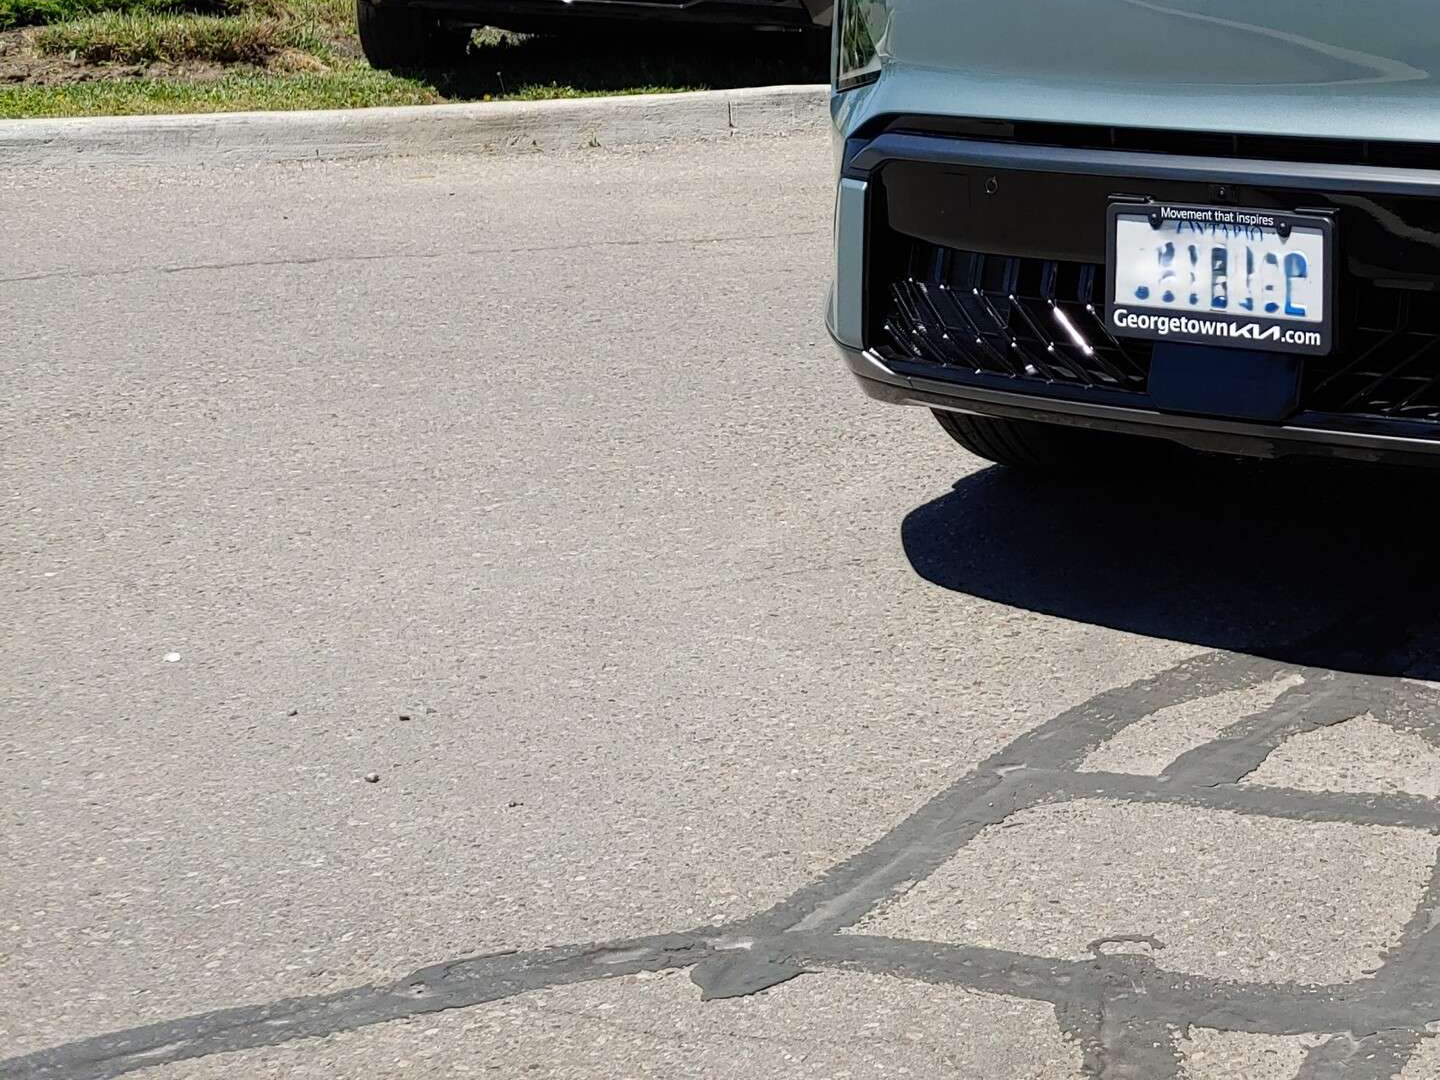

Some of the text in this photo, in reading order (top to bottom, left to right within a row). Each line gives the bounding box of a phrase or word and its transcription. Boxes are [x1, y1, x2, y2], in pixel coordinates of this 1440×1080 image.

[1161, 207, 1274, 226] Movement that inspires
